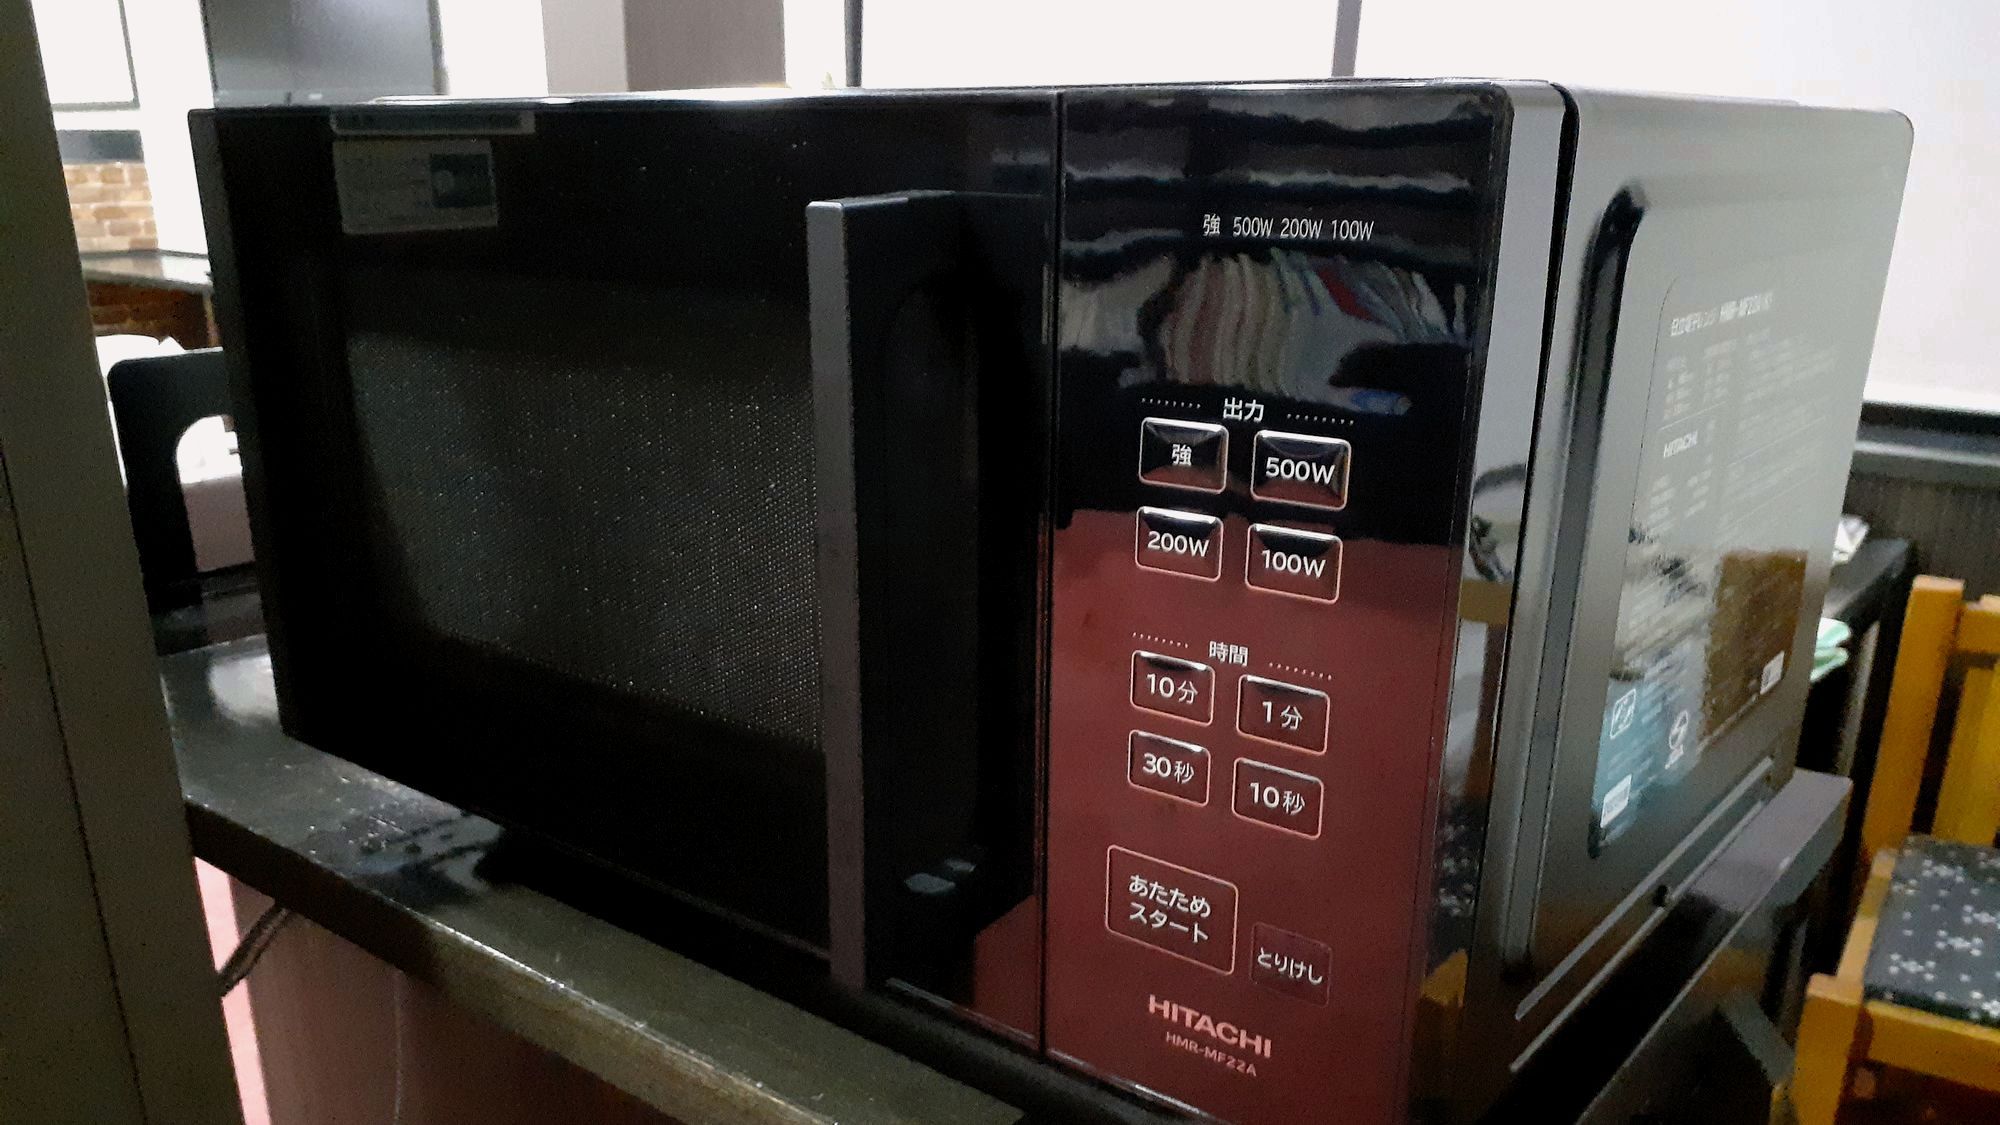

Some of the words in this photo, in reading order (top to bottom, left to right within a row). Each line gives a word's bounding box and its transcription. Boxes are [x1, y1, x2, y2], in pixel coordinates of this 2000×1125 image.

[1202, 213, 1221, 236] 強
[1232, 216, 1273, 238] 500W
[1279, 217, 1323, 239] 200W
[1330, 219, 1374, 241] 100W
[1222, 397, 1264, 422] 出力
[1171, 444, 1192, 467] 強
[1265, 457, 1335, 484] 500W
[1147, 530, 1209, 558] 200W
[1261, 549, 1326, 579] 100W
[1208, 640, 1249, 667] 時間
[1146, 673, 1198, 705] 10分
[1142, 752, 1194, 784] 30秒
[1250, 782, 1305, 815] 10秒
[1129, 874, 1211, 918] あたため
[1129, 901, 1209, 944] スタート
[1257, 946, 1323, 985] とりけし
[1149, 994, 1272, 1059] HITACHI
[1166, 1031, 1257, 1077] HMR-MF22A
